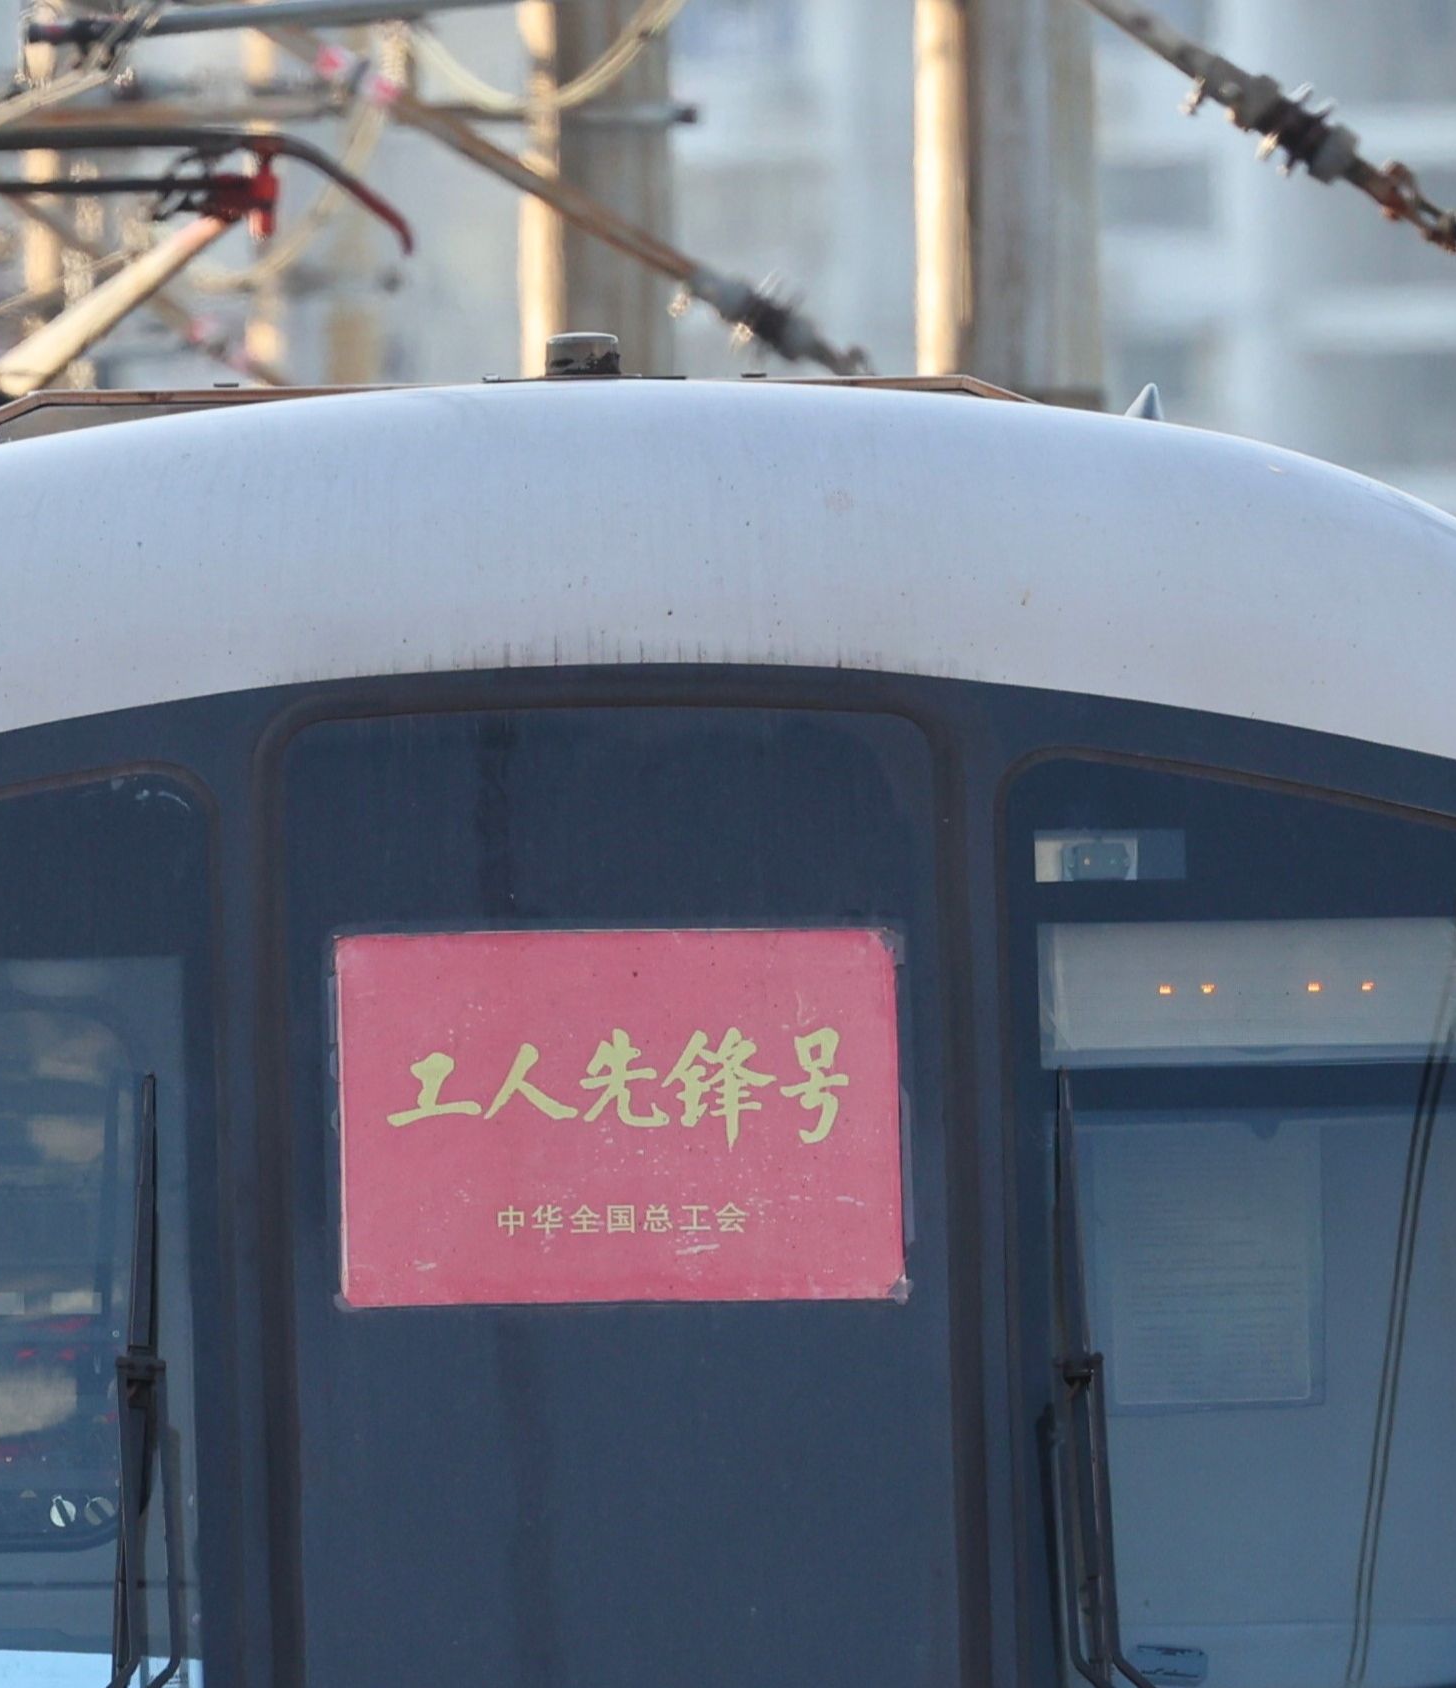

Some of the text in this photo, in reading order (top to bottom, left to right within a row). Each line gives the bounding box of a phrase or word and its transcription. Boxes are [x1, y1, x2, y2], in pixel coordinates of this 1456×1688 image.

[387, 1026, 850, 1152] 工人先锋号
[495, 1202, 750, 1239] 中华全国总工会
